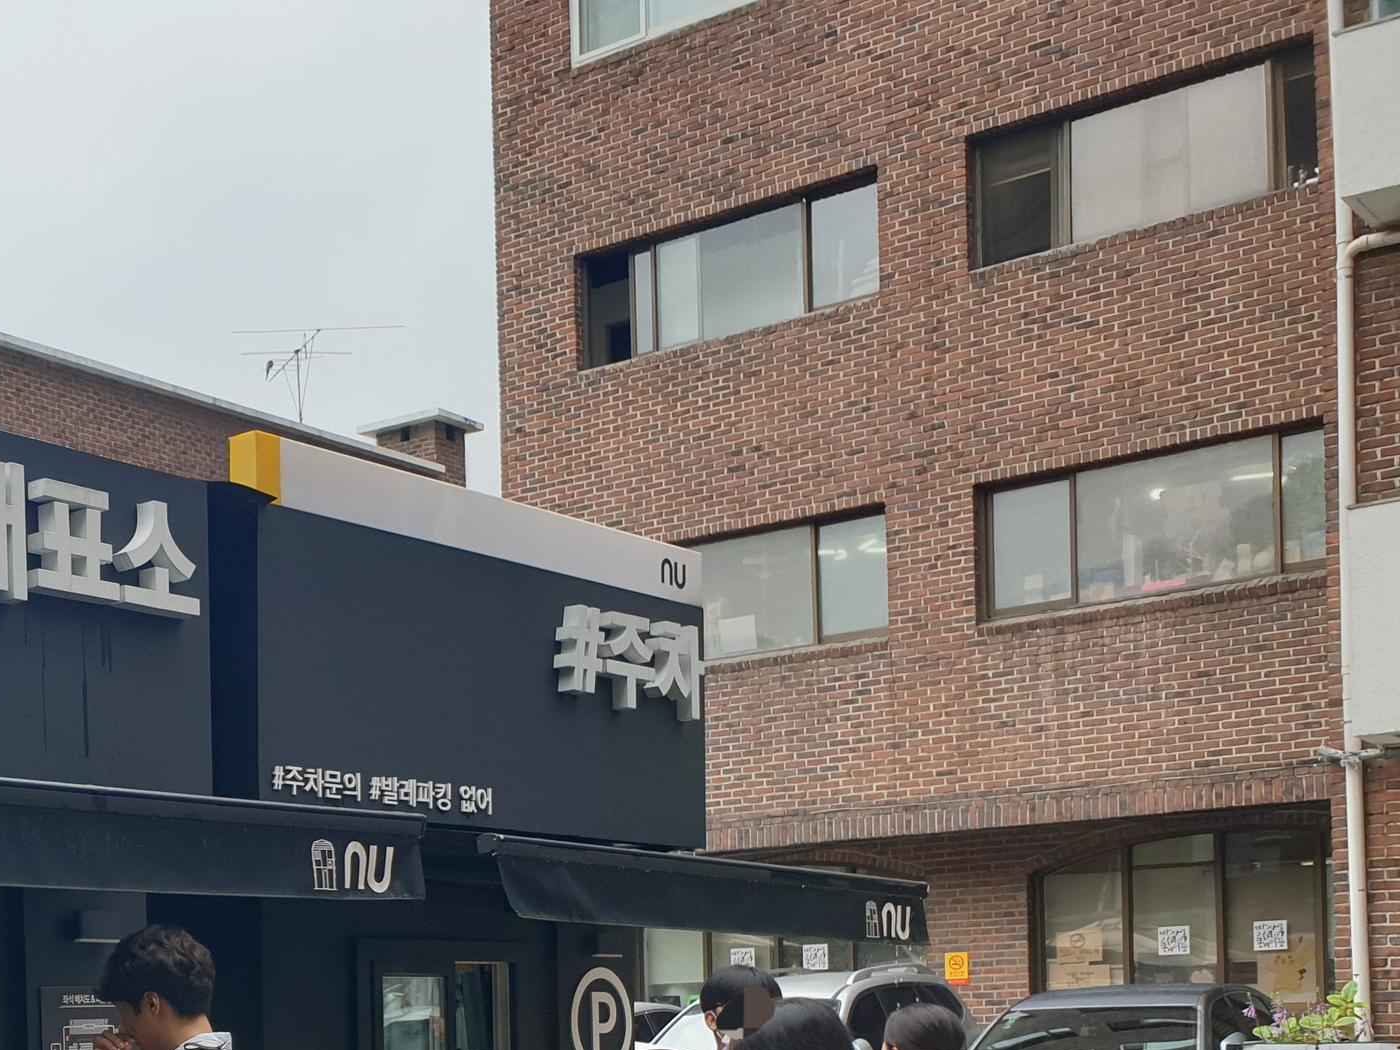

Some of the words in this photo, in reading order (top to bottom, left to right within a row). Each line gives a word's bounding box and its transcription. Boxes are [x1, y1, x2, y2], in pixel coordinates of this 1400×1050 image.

[553, 604, 704, 721] #주차
[272, 765, 362, 801] #주차문의
[369, 776, 452, 811] #발레파킹
[459, 784, 493, 815] 없어
